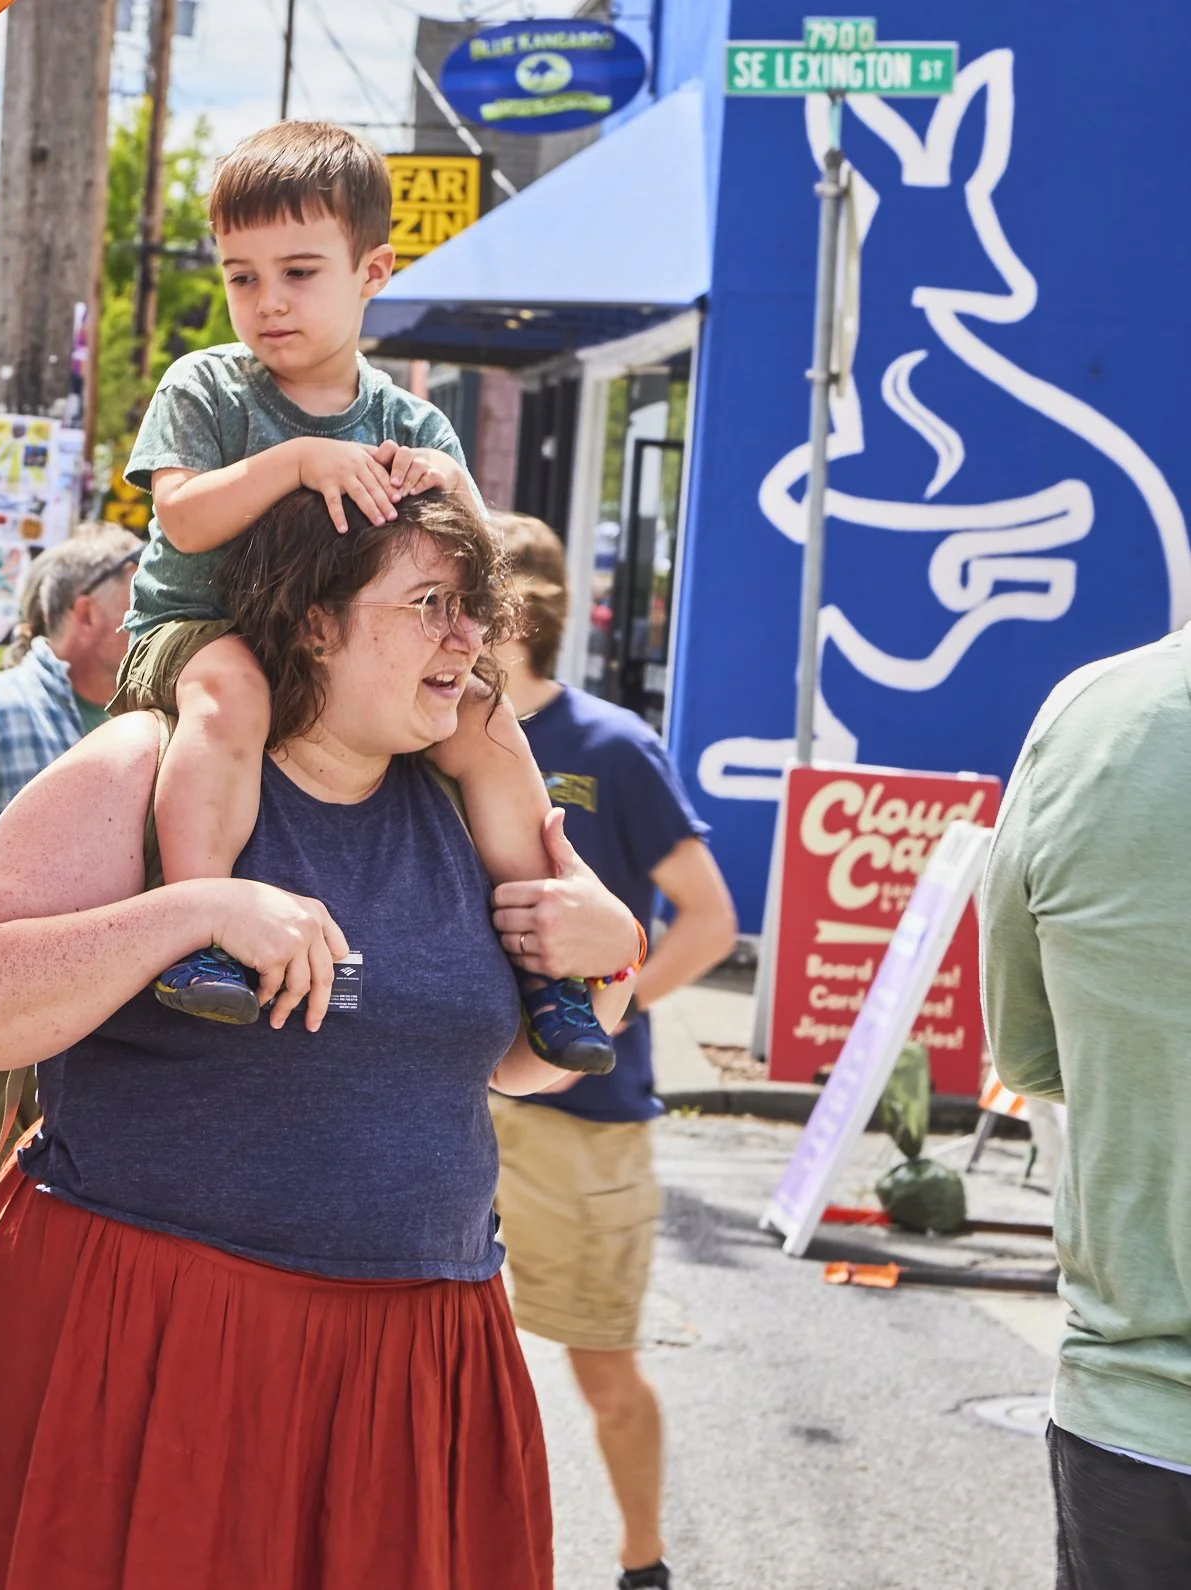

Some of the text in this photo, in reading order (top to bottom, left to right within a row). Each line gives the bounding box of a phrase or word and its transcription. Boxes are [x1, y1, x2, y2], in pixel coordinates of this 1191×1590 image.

[808, 22, 874, 49] 7900
[733, 51, 945, 89] SE LEXINGTON ST
[800, 779, 986, 857] Cloud
[828, 834, 938, 910] Ca
[806, 953, 874, 982] Board
